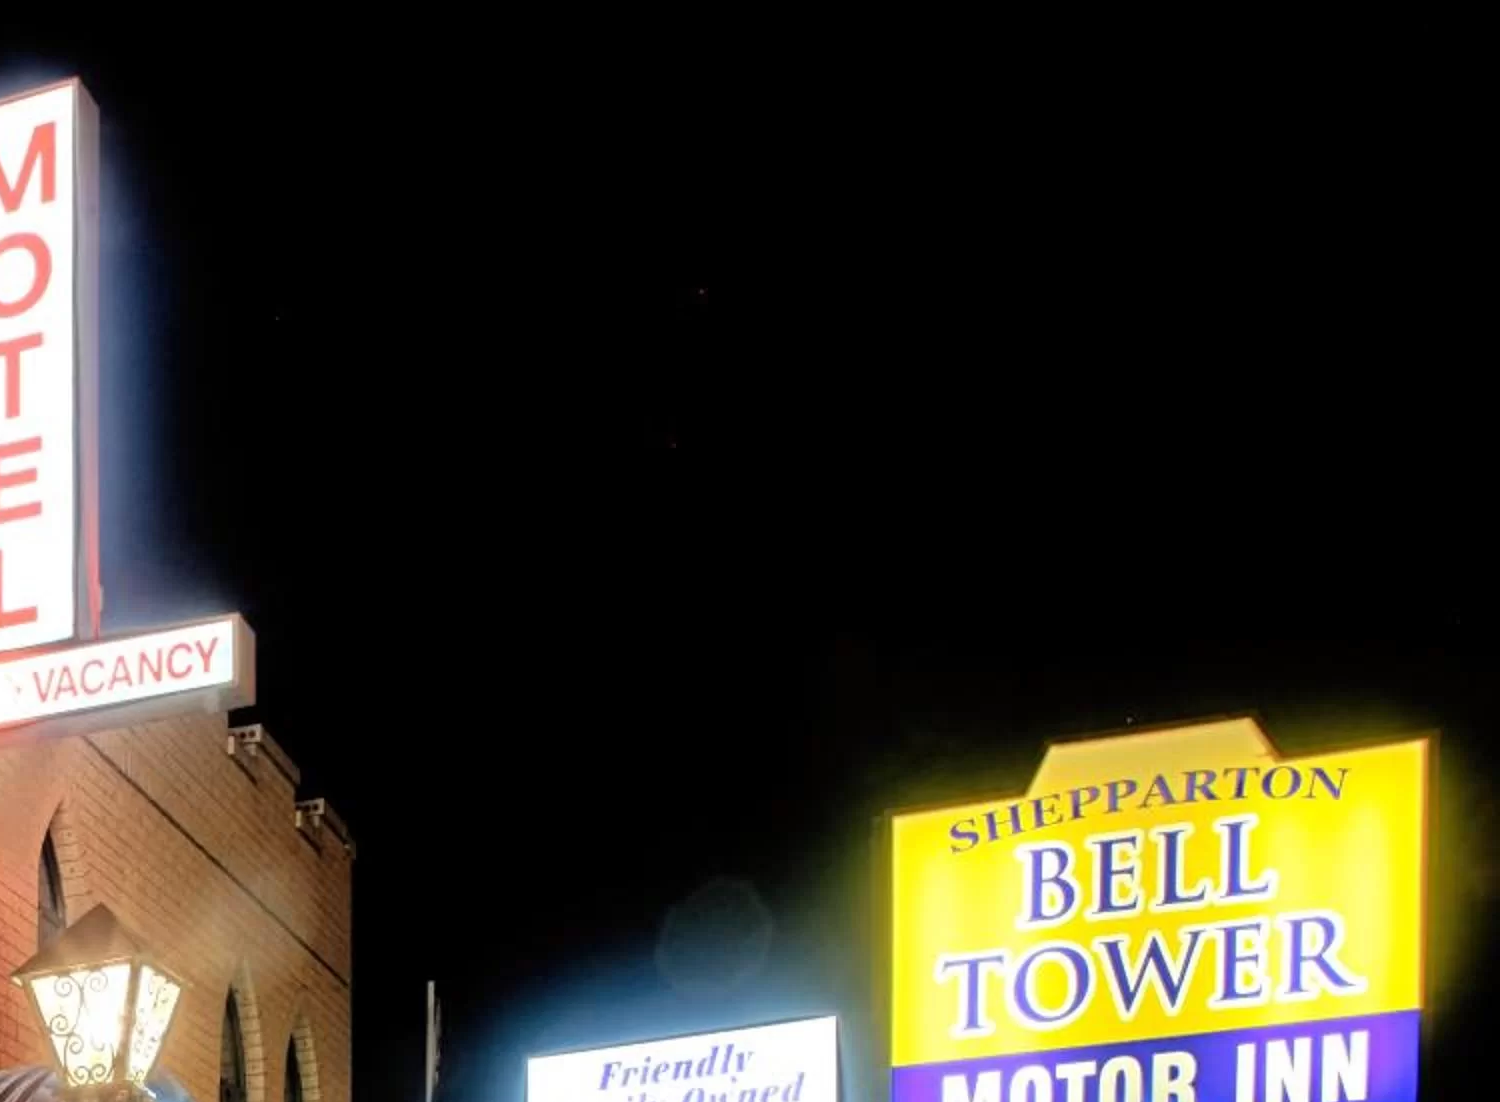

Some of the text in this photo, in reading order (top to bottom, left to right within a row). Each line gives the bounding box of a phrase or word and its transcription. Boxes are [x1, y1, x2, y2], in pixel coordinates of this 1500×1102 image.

[32, 637, 219, 703] VACANCY
[949, 766, 1353, 855] SHEPPARTON
[1022, 817, 1274, 926] BELL
[942, 916, 1358, 1033] TOWER
[597, 1043, 754, 1091] Friendly
